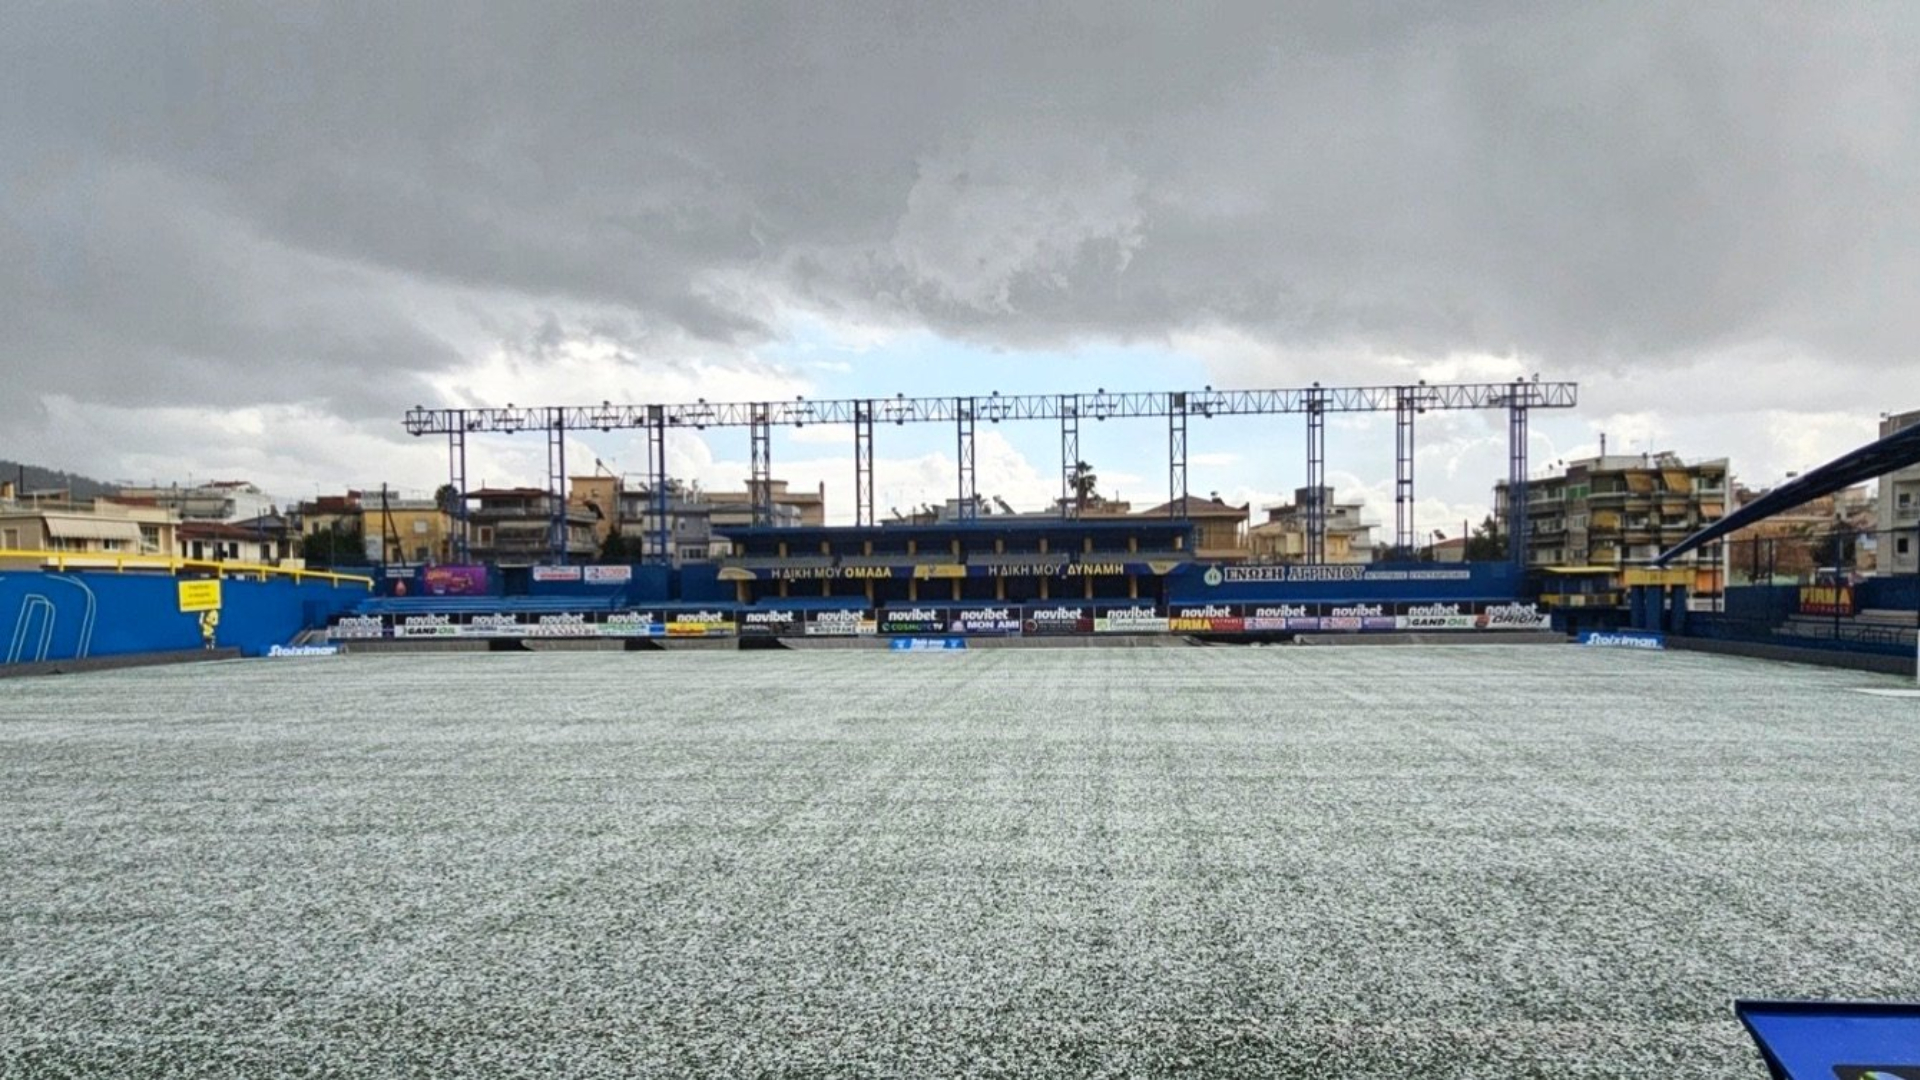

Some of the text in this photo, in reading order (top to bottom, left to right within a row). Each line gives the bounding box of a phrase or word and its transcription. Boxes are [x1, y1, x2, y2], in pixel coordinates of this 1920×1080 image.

[783, 567, 811, 579] ΔΙΚΗ
[814, 567, 842, 579] ΜΟΥ
[844, 566, 892, 579] ΟΜΑΔΑ
[1001, 563, 1029, 577] ΔΙΚΗ
[1033, 563, 1061, 576] ΜΟΥ
[1067, 563, 1124, 576] ΔΥΝΑΜΗ
[1225, 566, 1285, 582] ΕΝΩΣΗ
[1288, 565, 1365, 581] ΑΓΡΙΝΙΟΥ
[1800, 586, 1851, 605] FIRMA
[888, 609, 937, 621] novibet
[961, 608, 1009, 621] novibet
[1034, 607, 1082, 620] novibet
[1107, 606, 1156, 619] novibet
[1181, 605, 1231, 618] novibet
[1256, 605, 1307, 617] novibet
[1332, 604, 1383, 617] novibet
[1408, 603, 1460, 616] novibet
[1485, 602, 1538, 616] novibet
[405, 614, 450, 625] novibet
[472, 613, 517, 625] novibet
[540, 613, 584, 625] novibet
[607, 612, 653, 624] novibet
[676, 611, 723, 623] novibet
[746, 610, 793, 623] novibet
[817, 610, 864, 622] novibet
[1411, 617, 1468, 626] GAND OIL
[1492, 614, 1545, 625] ORIGIN
[407, 626, 438, 635] GAND
[933, 621, 944, 631] TV
[967, 619, 1019, 630] MON AMI
[1170, 618, 1213, 631] FIRMA
[1586, 632, 1658, 648] Stoiximan
